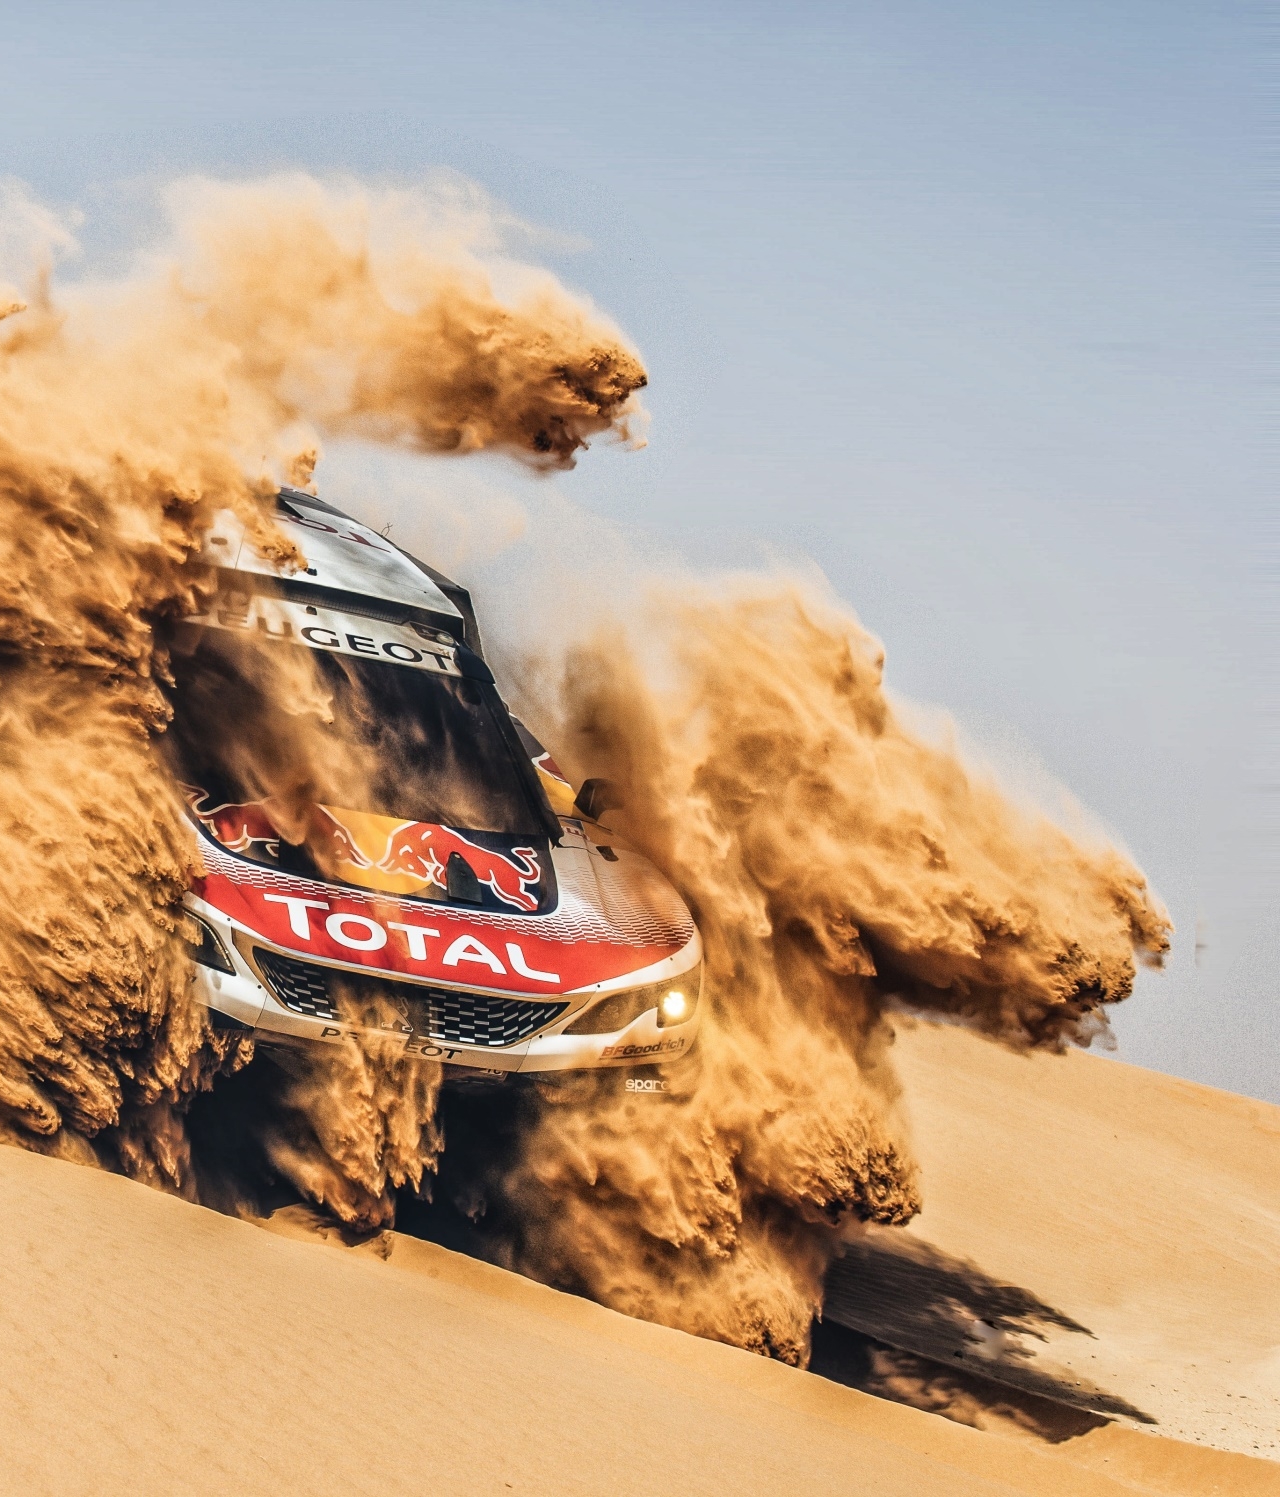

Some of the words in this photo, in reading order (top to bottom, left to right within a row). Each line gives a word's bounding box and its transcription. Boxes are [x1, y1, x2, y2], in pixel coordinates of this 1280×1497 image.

[185, 604, 451, 670] EUGEOT
[263, 893, 560, 983] TOTAL
[601, 1037, 685, 1057] BFGoodrich
[625, 1079, 669, 1093] sparc
